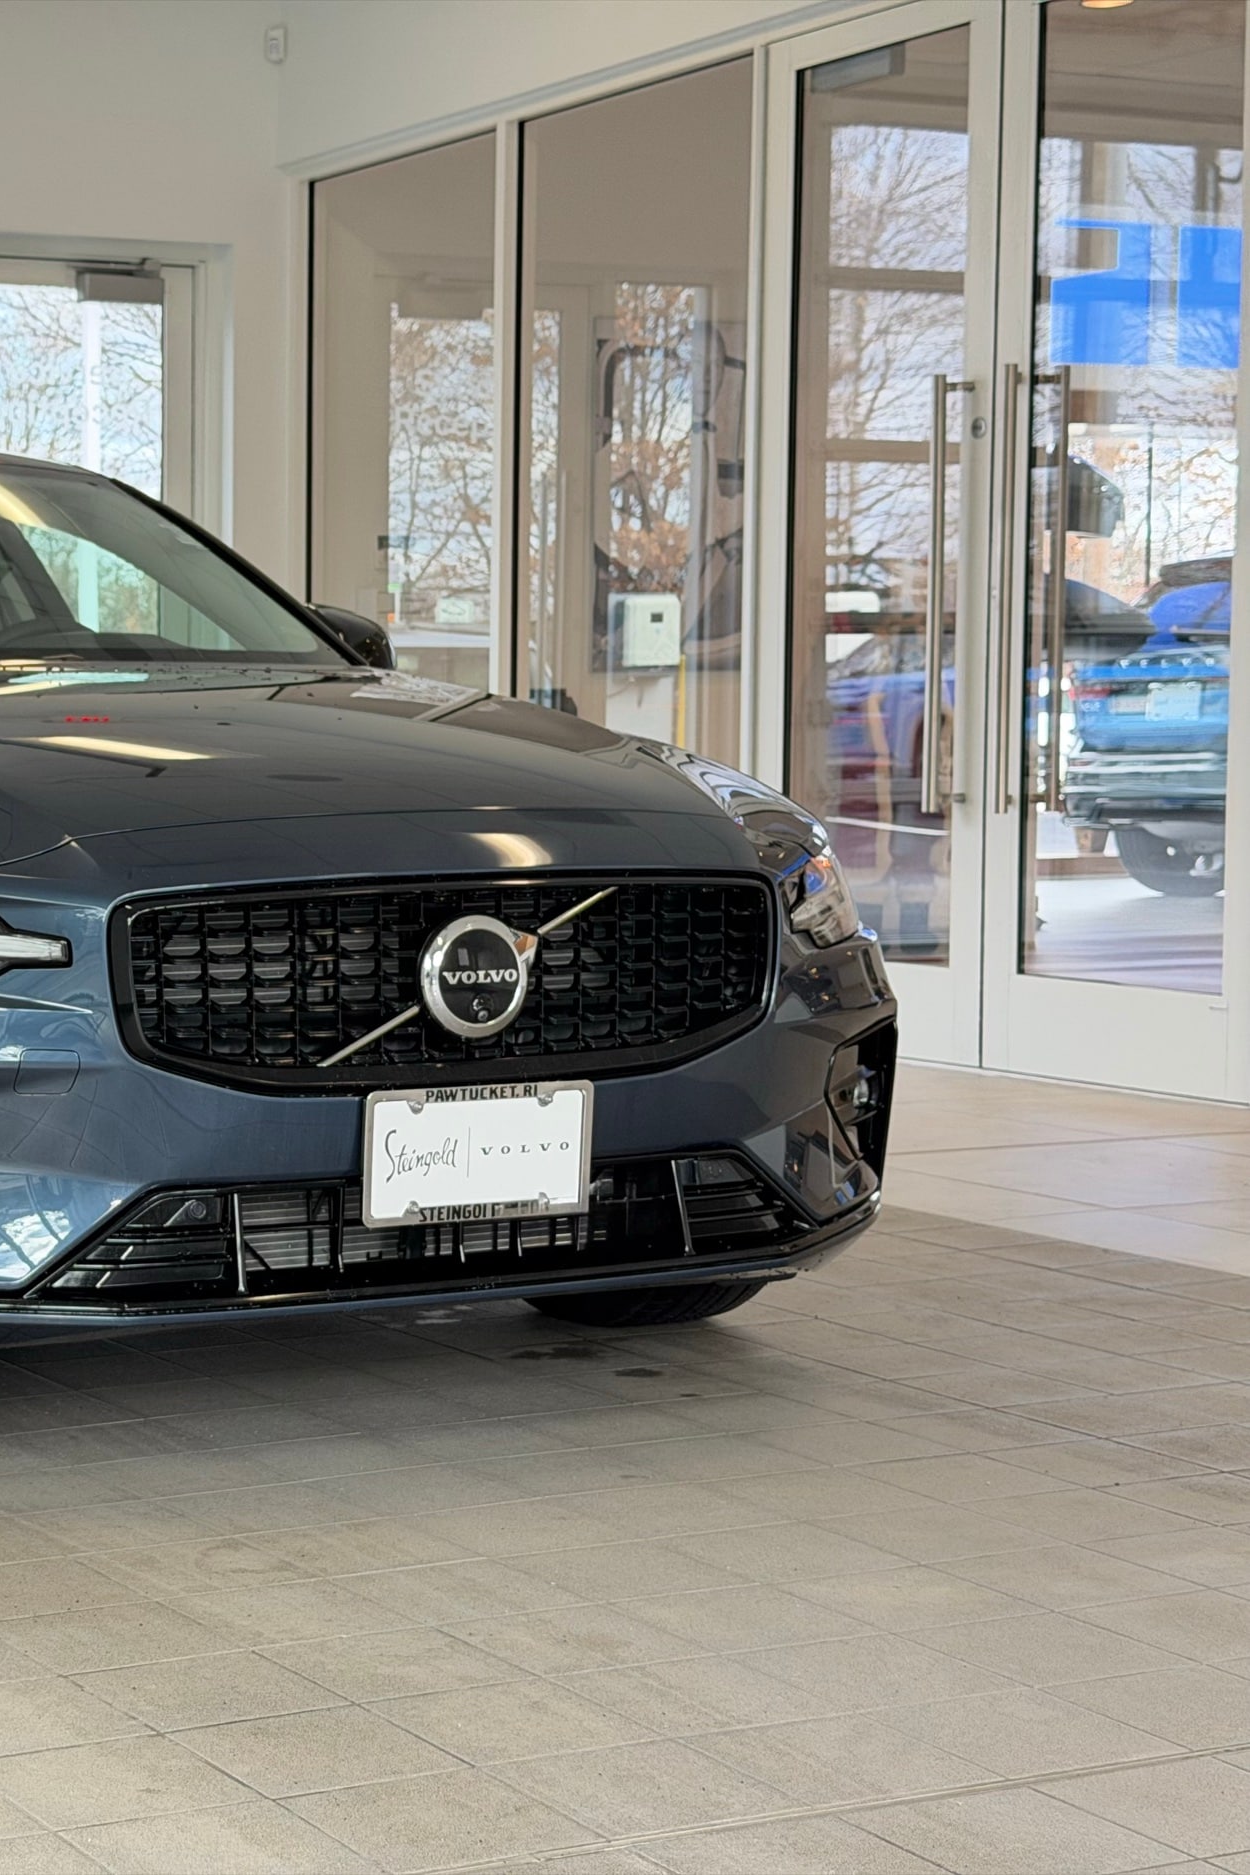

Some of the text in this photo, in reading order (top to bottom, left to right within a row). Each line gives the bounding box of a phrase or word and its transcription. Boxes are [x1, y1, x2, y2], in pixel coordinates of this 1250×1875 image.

[442, 968, 518, 985] VOLVO
[523, 1084, 538, 1098] RI
[384, 1129, 570, 1183] Steingold VOLVO
